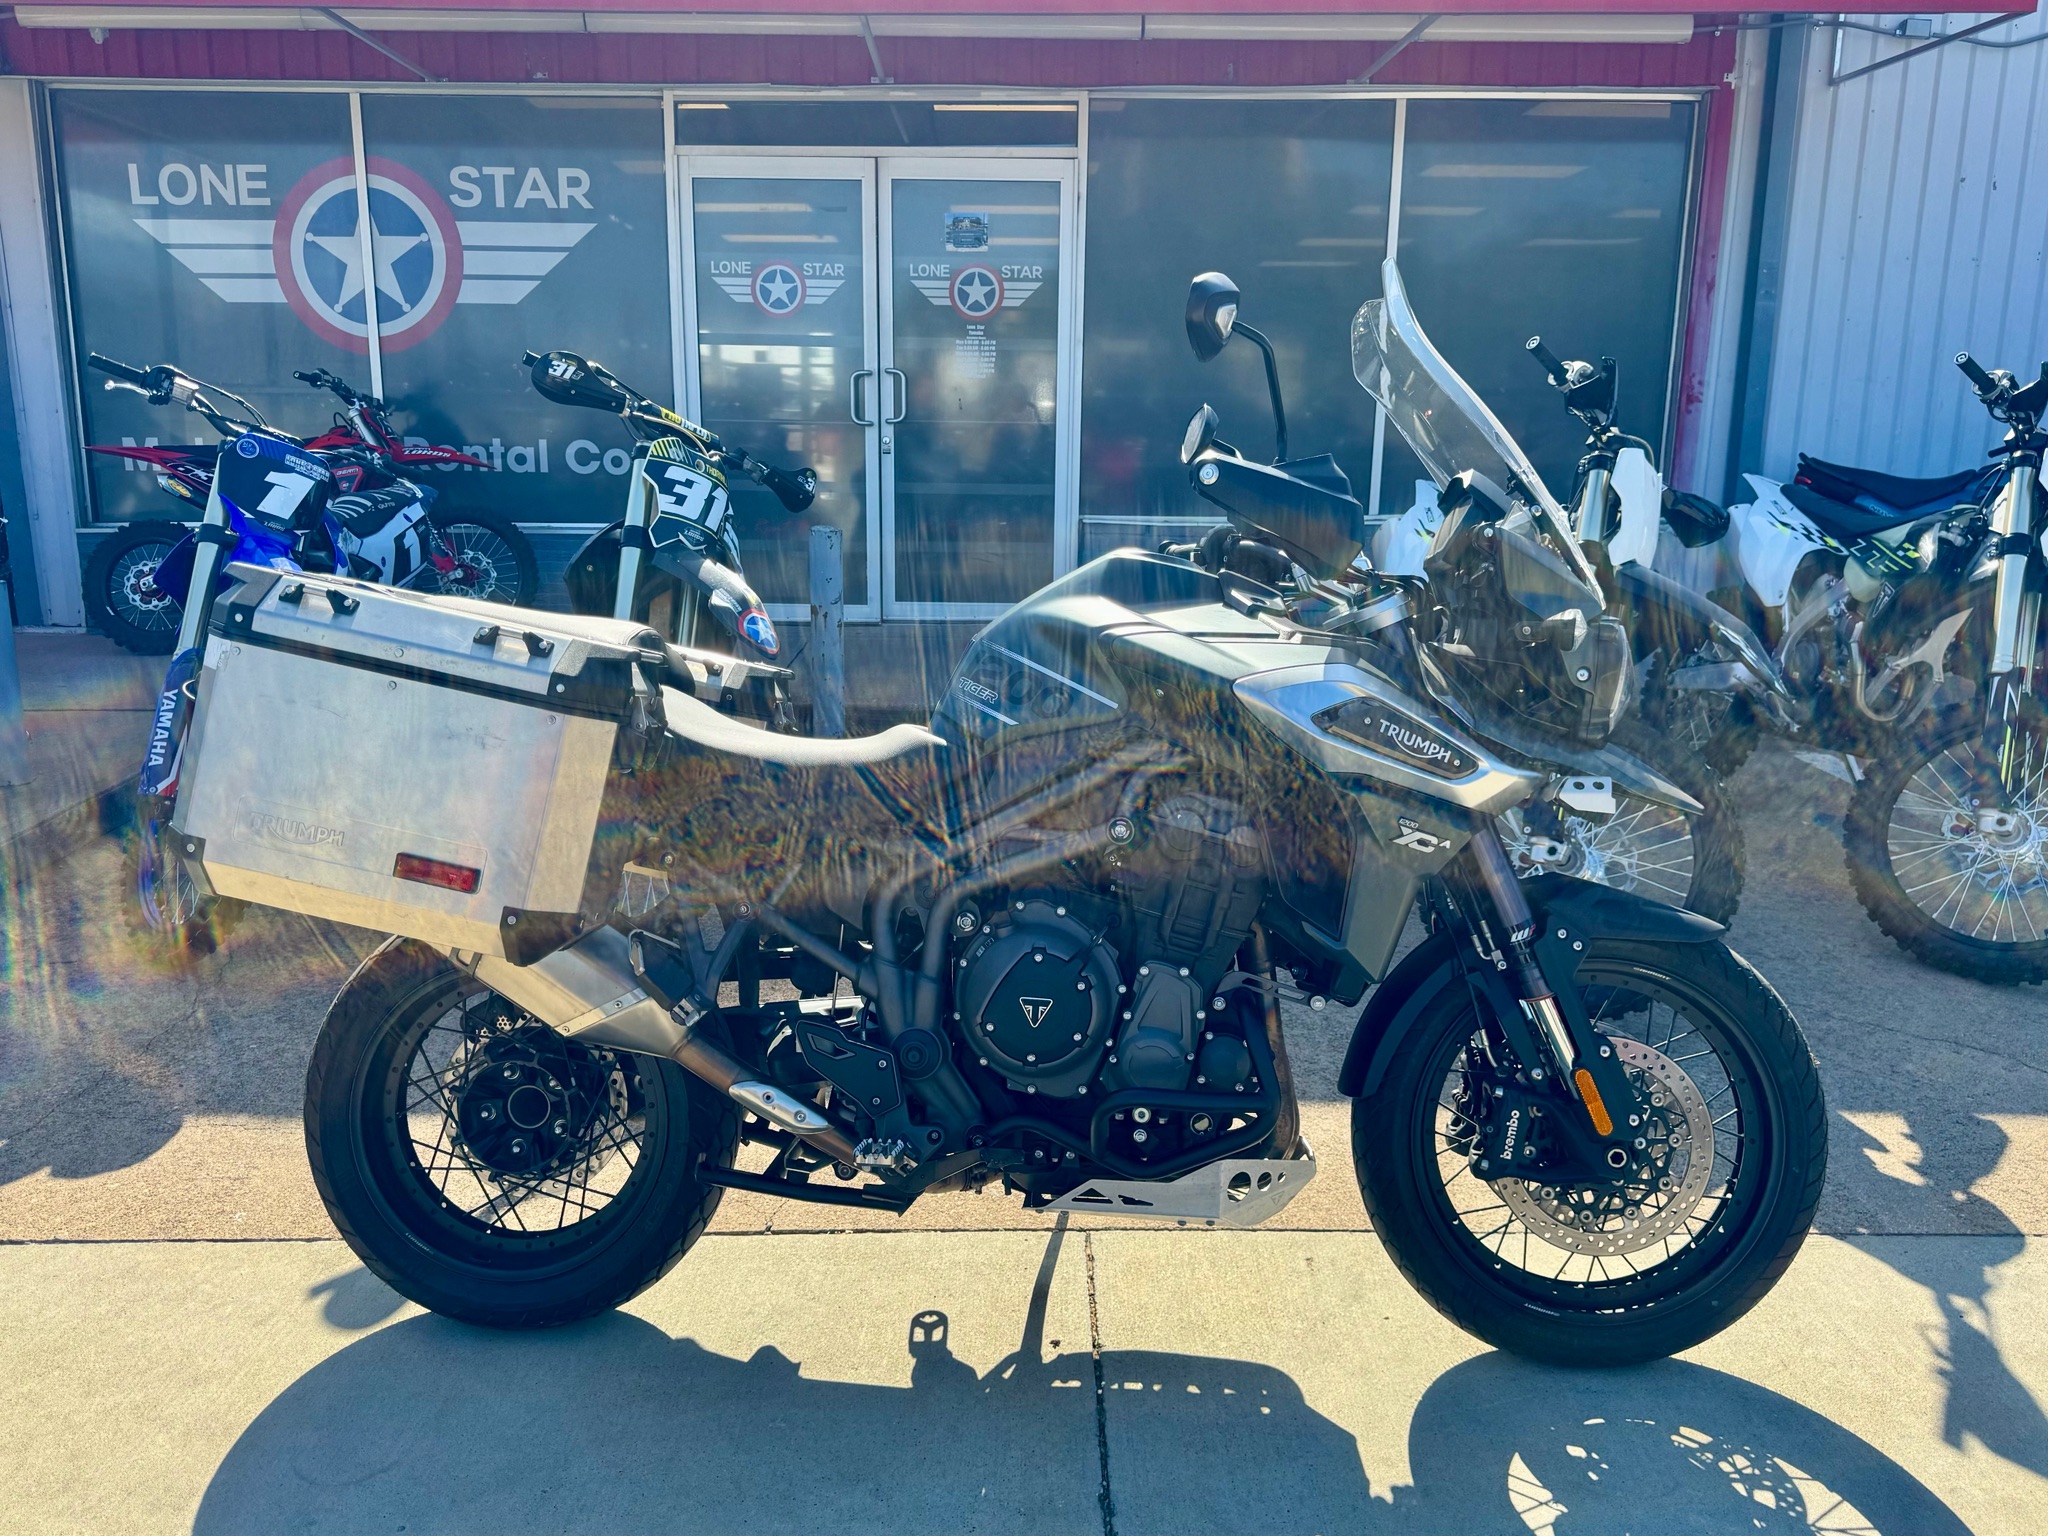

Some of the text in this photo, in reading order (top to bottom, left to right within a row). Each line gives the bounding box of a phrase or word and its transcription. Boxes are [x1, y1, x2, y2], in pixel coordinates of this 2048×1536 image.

[128, 163, 594, 209] LONE STAR
[710, 260, 845, 277] LONE STAR
[909, 263, 1043, 279] LONE STAR
[256, 471, 316, 521] 1
[658, 465, 728, 533] 31
[959, 676, 999, 705] TIGER
[148, 688, 179, 768] YAMAHA
[1379, 718, 1452, 764] TRIUMPH
[250, 811, 346, 848] TRIUMPH
[1500, 1109, 1520, 1160] brembo
